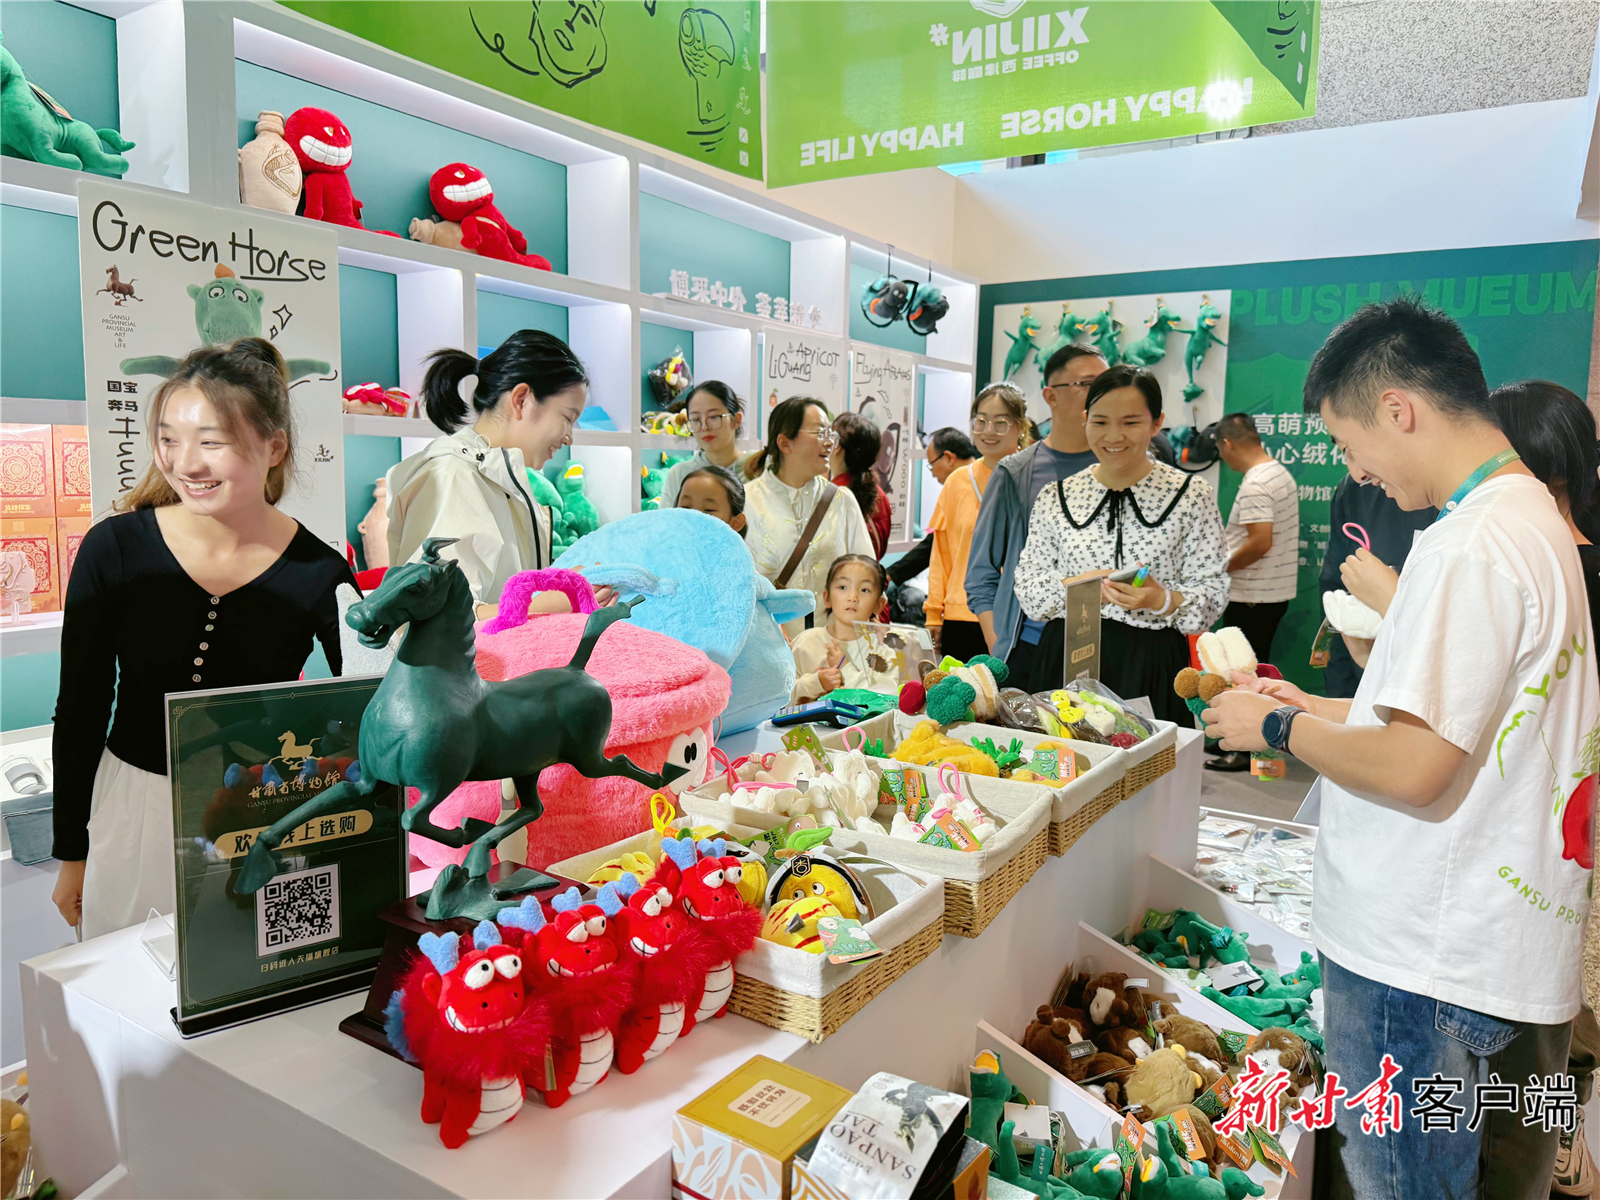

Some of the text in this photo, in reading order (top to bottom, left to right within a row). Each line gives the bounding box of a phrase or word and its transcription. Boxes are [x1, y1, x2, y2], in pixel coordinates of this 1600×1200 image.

[92, 200, 326, 281] Green Horse
[1230, 270, 1597, 326] PLUSH MUEUM
[101, 318, 137, 328] PROVINCIAL
[106, 325, 134, 333] MUSEUM
[109, 313, 130, 321] GANSU
[107, 380, 138, 394] 国宝
[107, 399, 138, 412] 奔马
[248, 770, 341, 799] 甘肃省博物馆
[247, 799, 270, 808] GANSU
[234, 815, 356, 854] 欢上选购
[1498, 866, 1586, 925] GANSU PRO
[840, 1114, 879, 1138] TAI
[830, 1124, 916, 1180] SANPAO
